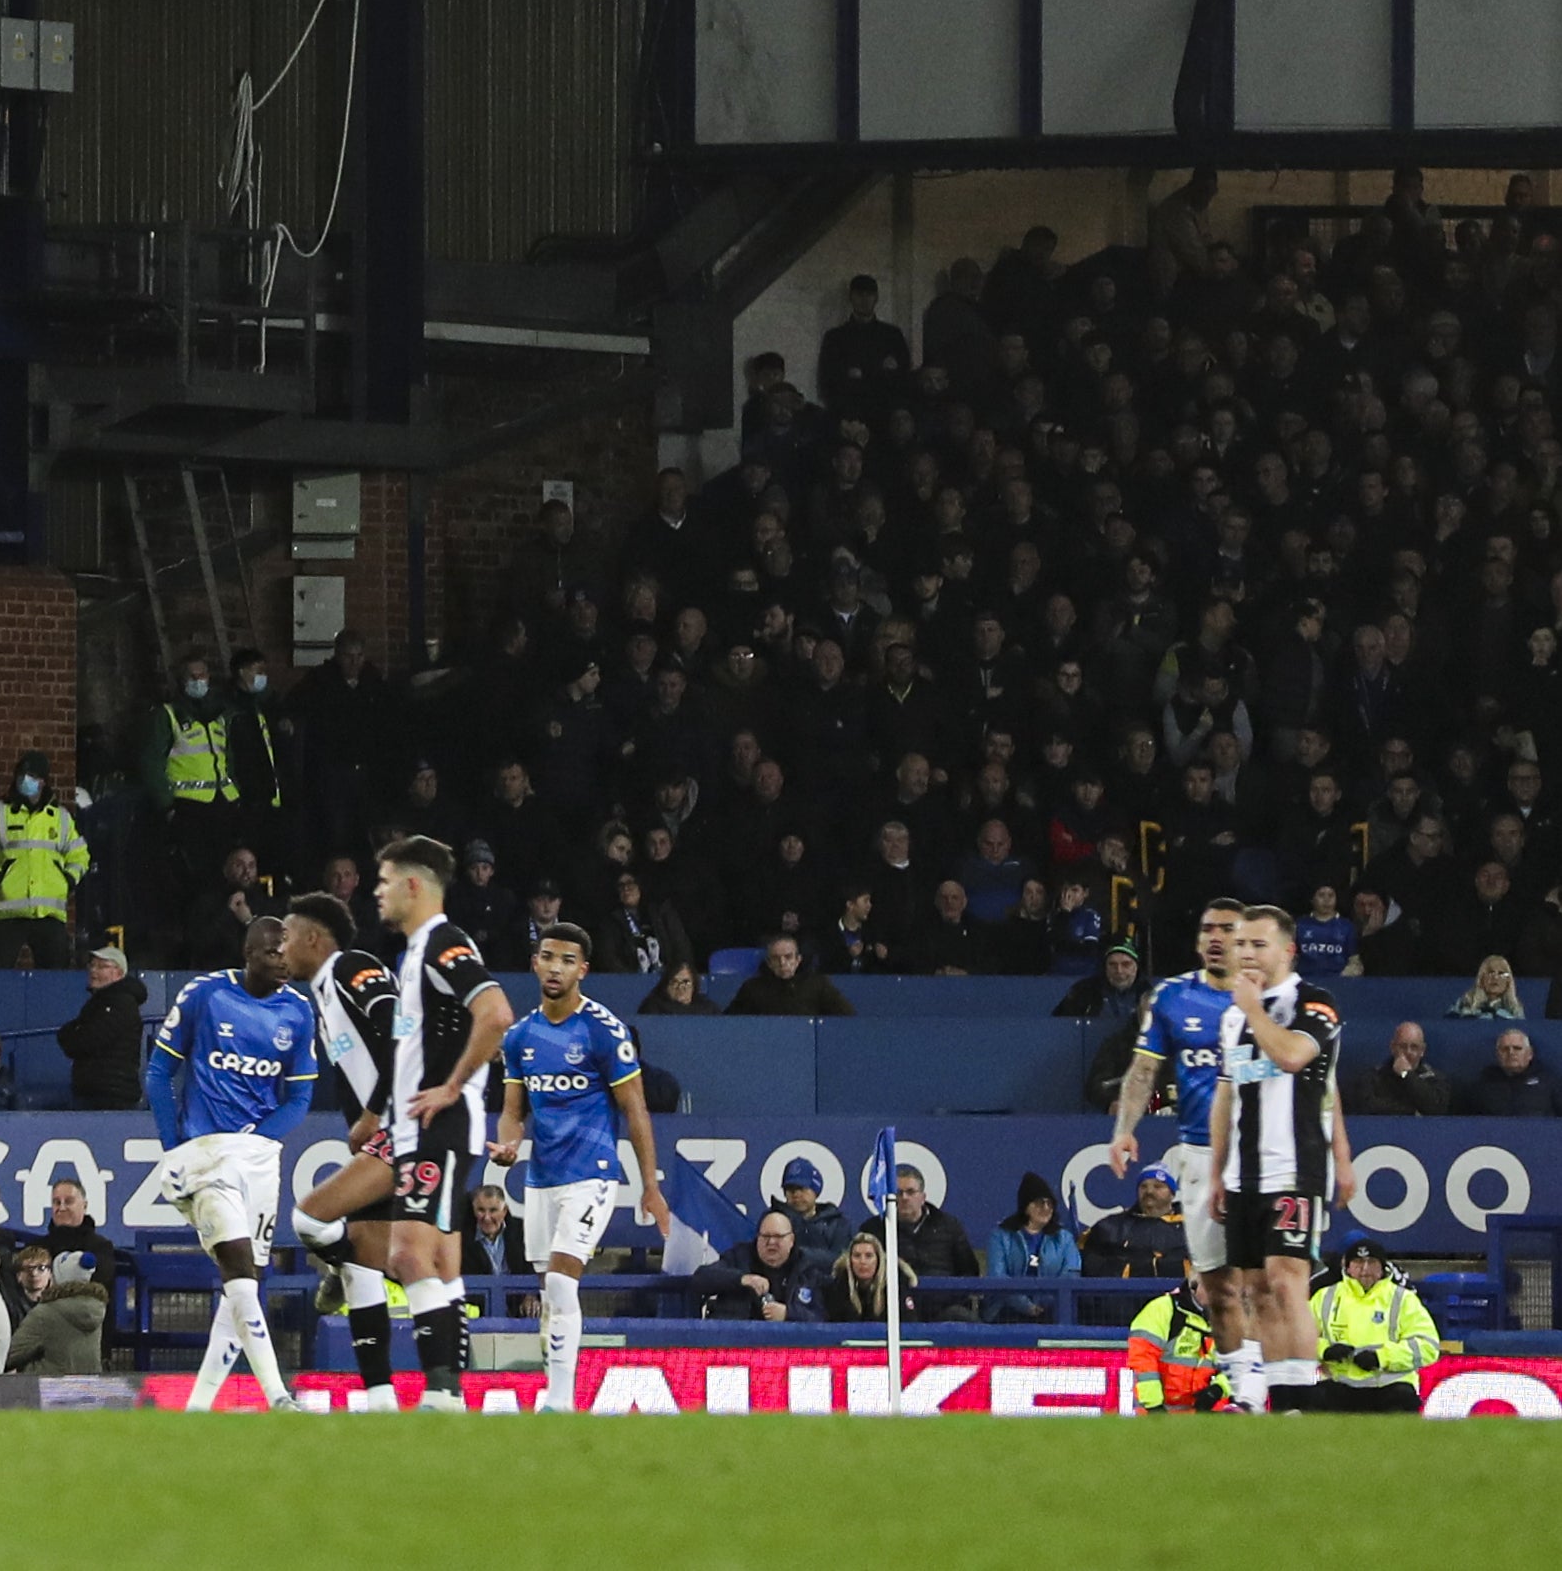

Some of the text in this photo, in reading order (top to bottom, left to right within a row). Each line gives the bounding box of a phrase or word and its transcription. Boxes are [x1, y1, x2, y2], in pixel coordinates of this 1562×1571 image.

[208, 1050, 282, 1077] CAZOO
[1180, 1048, 1222, 1067] CA
[254, 1212, 276, 1241] 16
[579, 1204, 595, 1232] 4
[1273, 1196, 1310, 1232] 21
